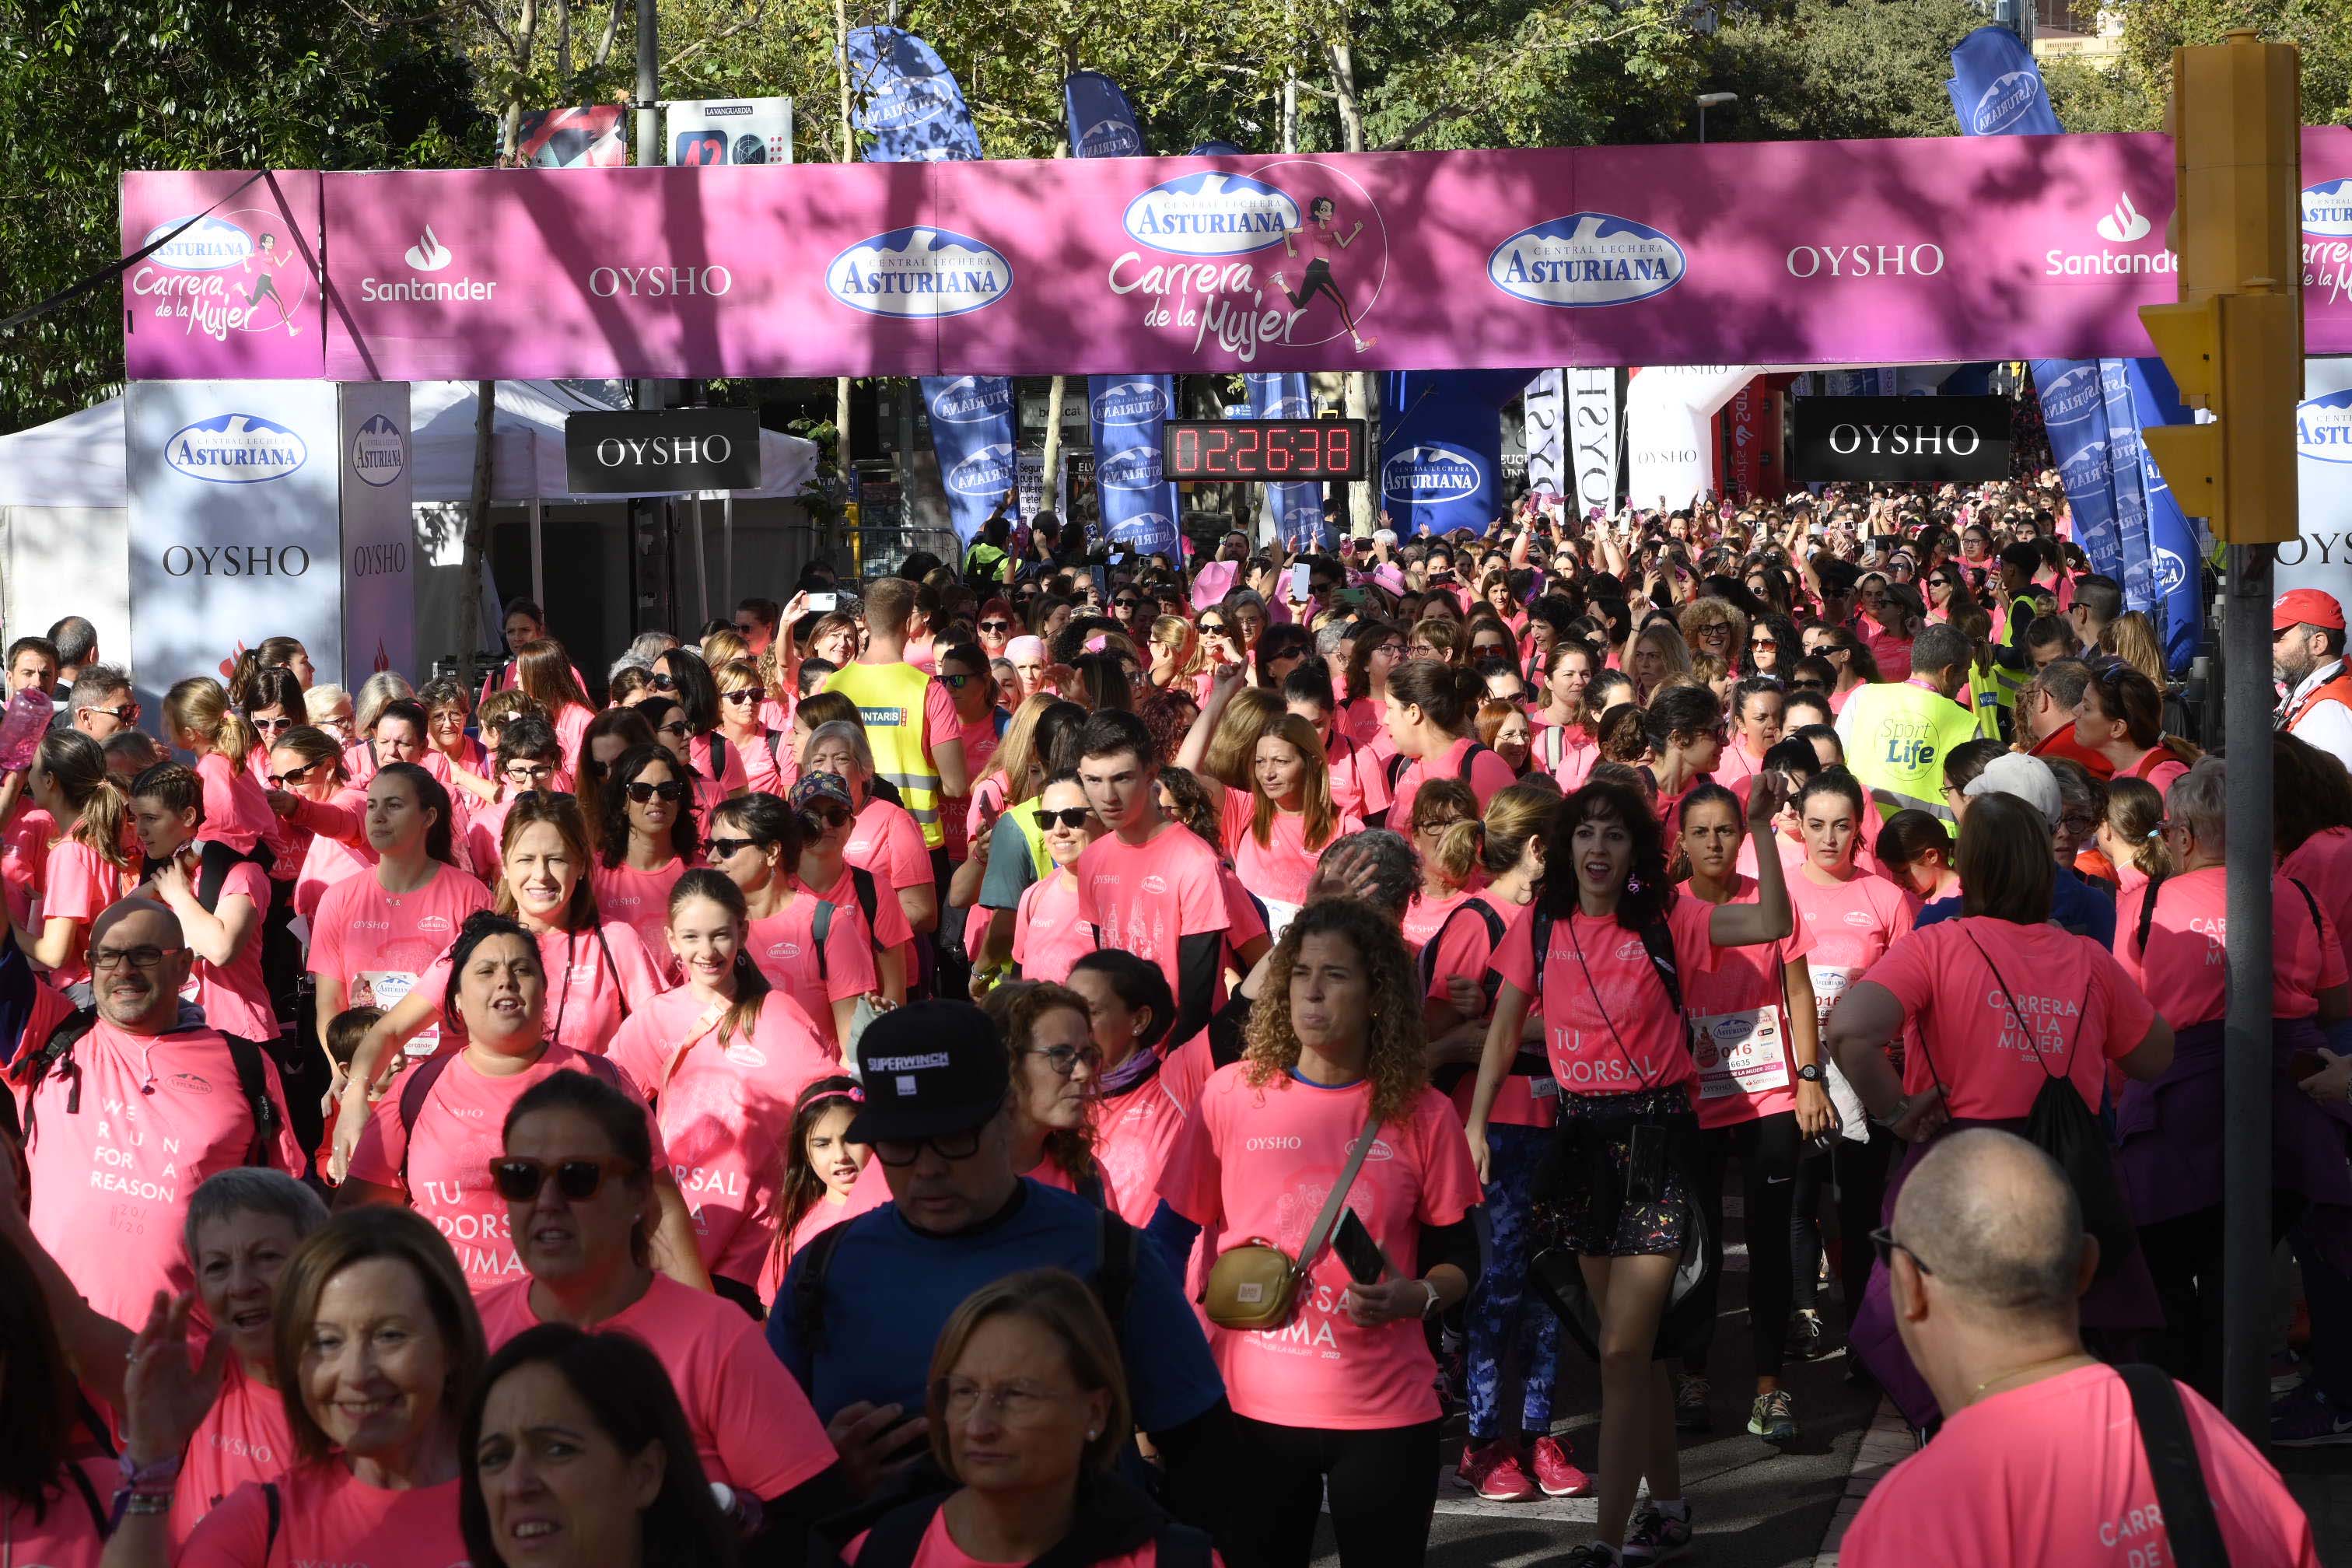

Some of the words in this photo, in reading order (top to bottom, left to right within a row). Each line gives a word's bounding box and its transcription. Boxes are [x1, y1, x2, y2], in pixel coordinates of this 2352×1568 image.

[1138, 204, 1287, 233] ASTURIANA
[868, 257, 928, 268] CENTRAL
[933, 257, 993, 267] LECHERA
[1533, 246, 1595, 257] CENTRAL
[1601, 243, 1664, 254] LECHERA
[1787, 243, 1944, 278] OYSHO
[842, 261, 999, 296] ASTURIANA
[1108, 251, 1253, 295] Carrera
[1503, 249, 1671, 284] ASTURIANA
[132, 267, 223, 296] Carrera
[361, 276, 498, 302] Santander
[589, 264, 732, 299] OYSHO
[2318, 270, 2333, 293] la
[155, 301, 173, 318] de
[175, 300, 188, 318] la
[187, 291, 258, 341] Mujer
[1144, 297, 1170, 327] de
[1177, 301, 1196, 327] la
[1192, 288, 1308, 362] Mujer
[597, 434, 731, 467] OYSHO
[1177, 429, 1351, 472] 02:26:38
[1829, 422, 1979, 456] OYSHO
[176, 440, 297, 466] ASTURIANA
[356, 441, 402, 469] ASTURIANA
[1638, 450, 1697, 464] OYSHO
[1385, 468, 1473, 491] ASTURIANA
[162, 545, 310, 576] OYSHO
[354, 542, 406, 578] OYSHO
[863, 712, 899, 722] NTARIS
[1881, 718, 1931, 739] Sport
[1885, 740, 1935, 770] Life
[608, 895, 641, 908] OYSHO
[353, 921, 389, 930] OYSHO
[1546, 949, 1587, 961] OYSHO
[378, 984, 409, 993] ASTURIAN
[1987, 989, 2079, 1017] CARRERA
[2004, 1013, 2031, 1031] DE
[2035, 1017, 2061, 1035] LA
[1555, 1027, 1580, 1052] TU
[1720, 1043, 1753, 1059] 016
[1997, 1031, 2065, 1055] MUJER
[866, 1052, 950, 1073] SUPERWINCH
[1559, 1055, 1657, 1083] DORSAL
[1727, 1059, 1751, 1069] 16635
[102, 1097, 136, 1122] WE
[1245, 1136, 1302, 1152] OYSHO
[93, 1146, 134, 1170] FOR
[163, 1162, 176, 1178] A
[89, 1171, 175, 1204] REASON
[423, 1181, 462, 1206] TU
[675, 1164, 739, 1196] RSAL
[436, 1213, 512, 1240] DORS
[455, 1247, 527, 1276] UMA
[2098, 1504, 2165, 1547] CARR
